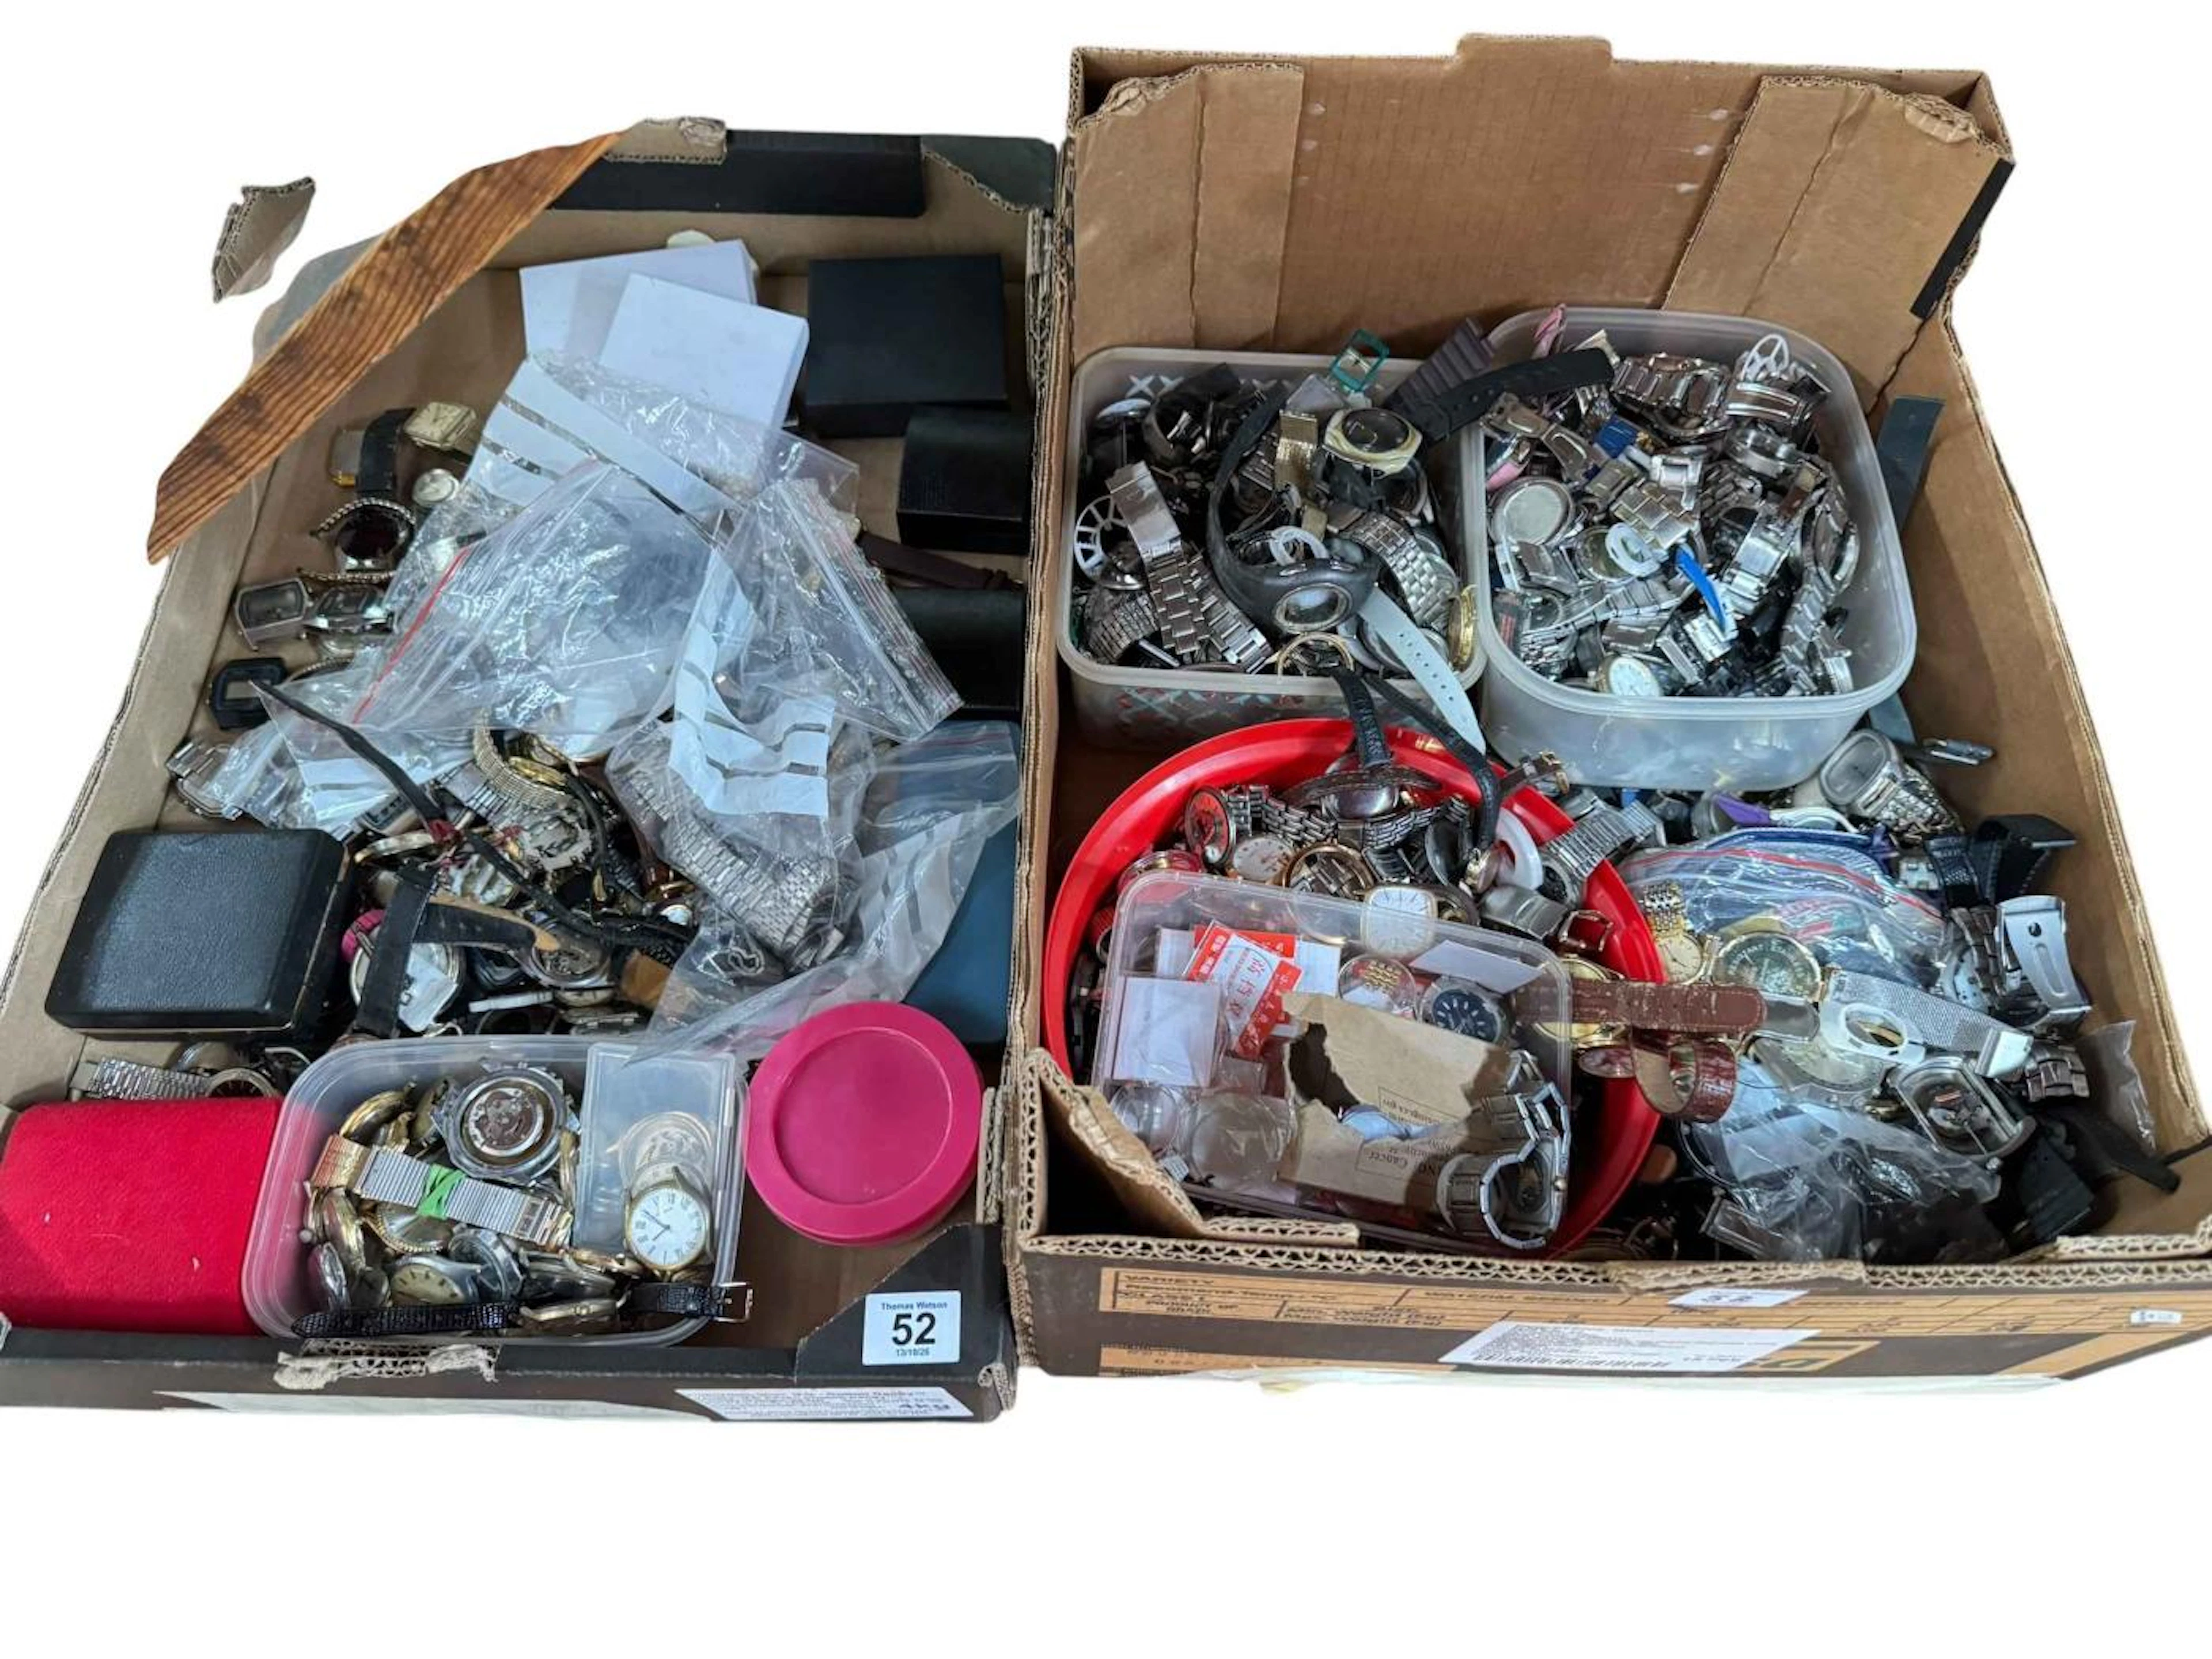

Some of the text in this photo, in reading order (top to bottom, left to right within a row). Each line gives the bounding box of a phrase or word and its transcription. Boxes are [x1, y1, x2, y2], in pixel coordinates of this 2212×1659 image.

[881, 1301, 948, 1310] Thomas Watson
[891, 1312, 936, 1345] 52
